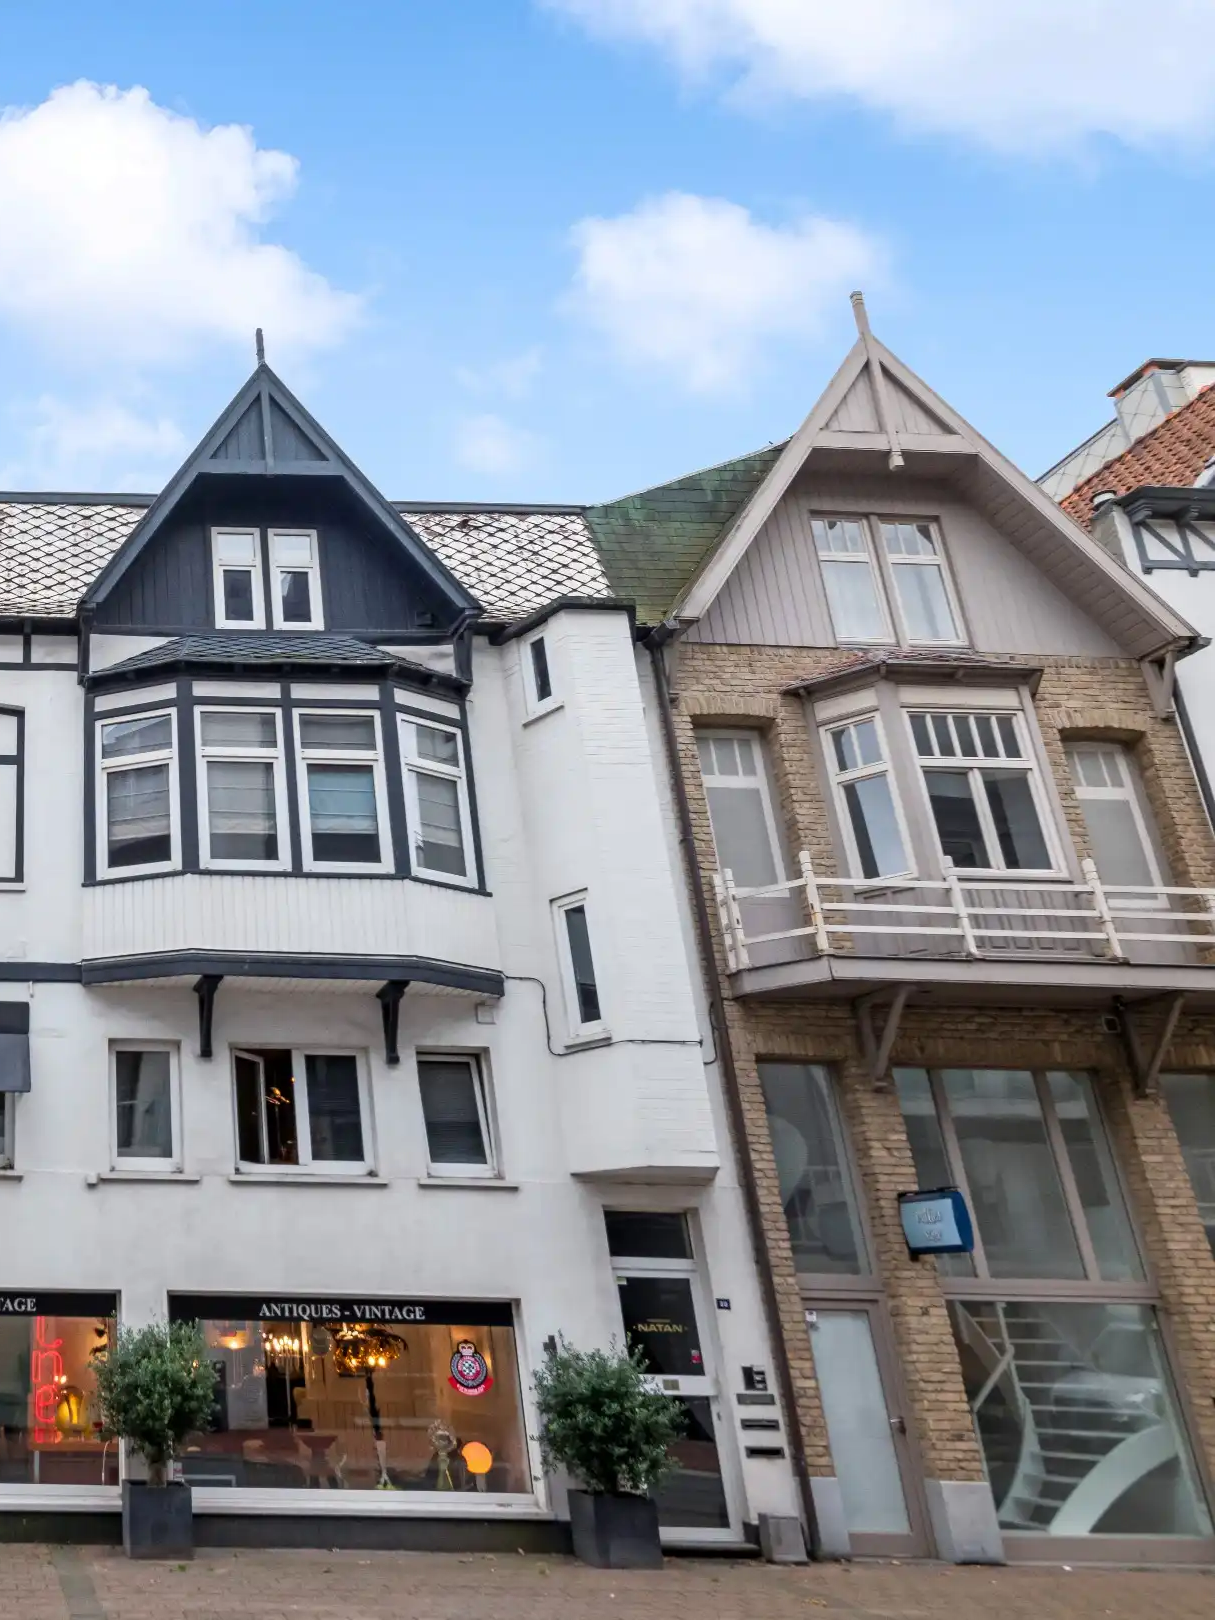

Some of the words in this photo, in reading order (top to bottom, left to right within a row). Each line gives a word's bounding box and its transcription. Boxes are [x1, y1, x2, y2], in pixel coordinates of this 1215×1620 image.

[259, 1303, 341, 1320] ANTIQUES
[353, 1305, 426, 1320] VINTAGE
[637, 1323, 683, 1333] NATAN
